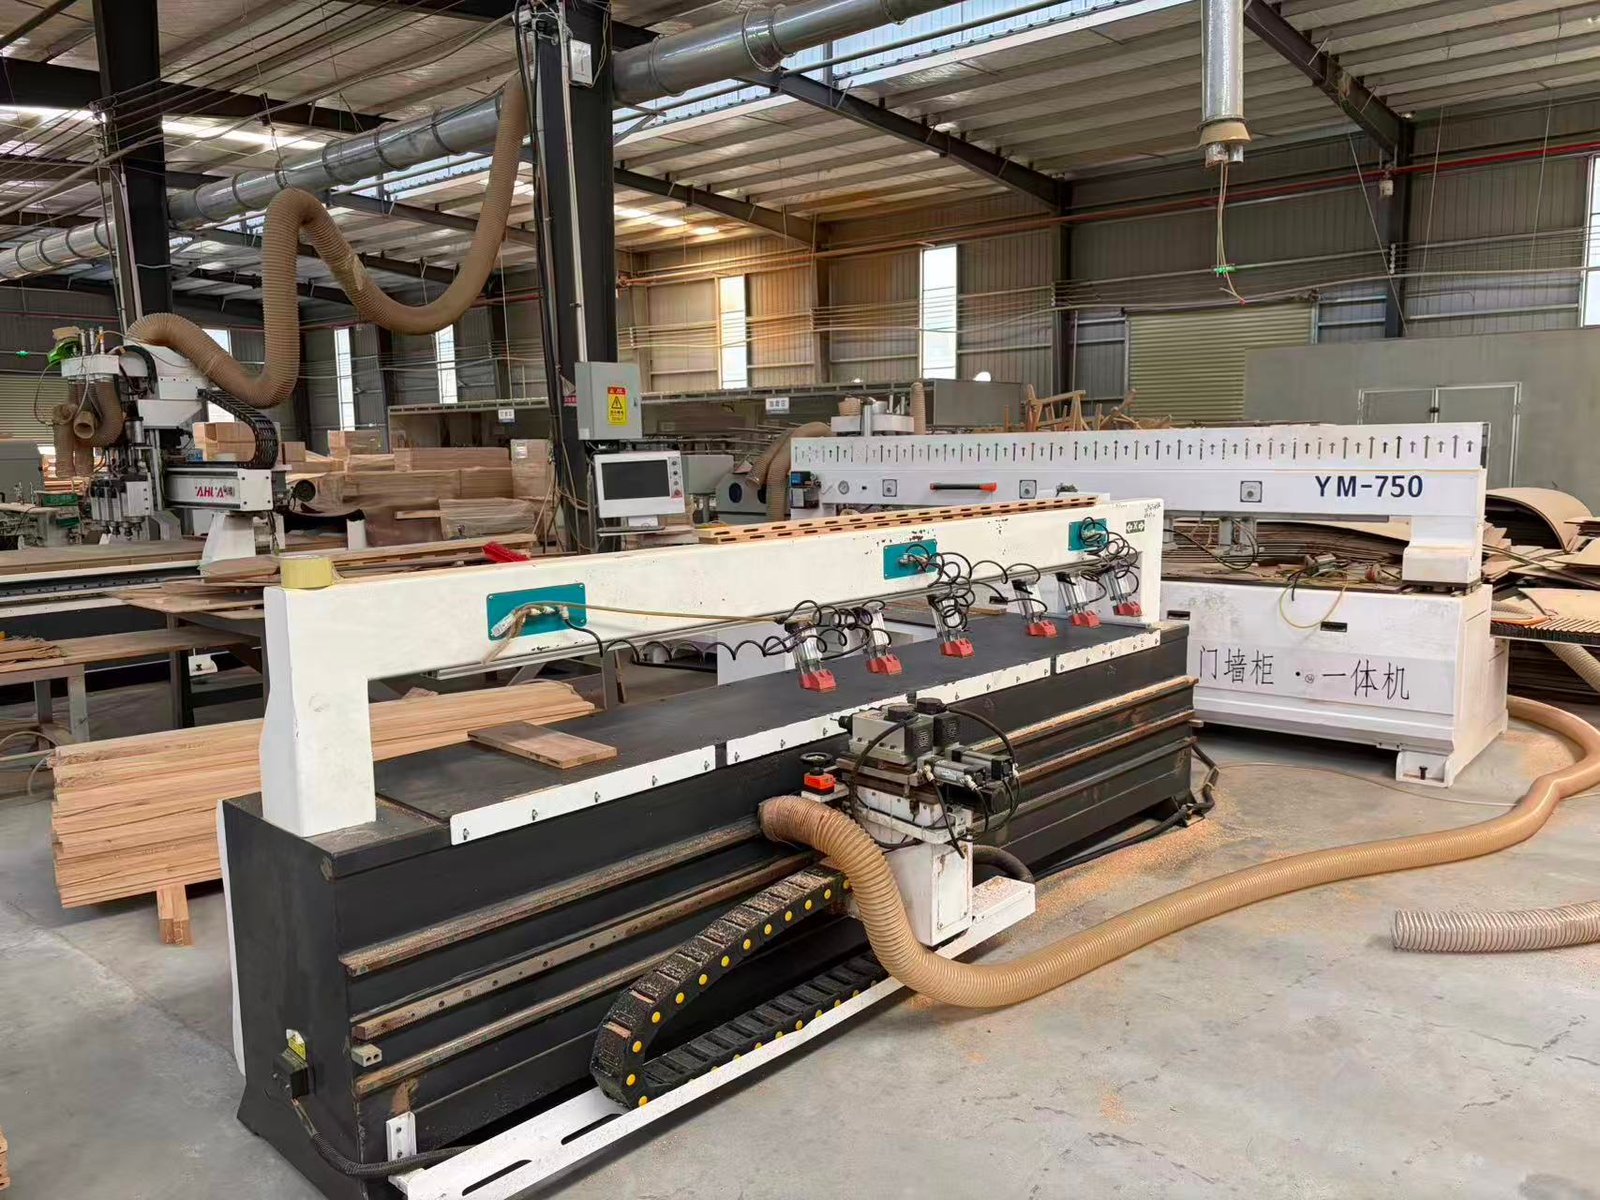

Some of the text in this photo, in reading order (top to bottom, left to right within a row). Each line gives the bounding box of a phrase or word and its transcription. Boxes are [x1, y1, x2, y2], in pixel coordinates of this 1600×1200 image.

[1315, 475, 1423, 498] YM-750
[1200, 645, 1410, 700] 门墙柜 一体机
